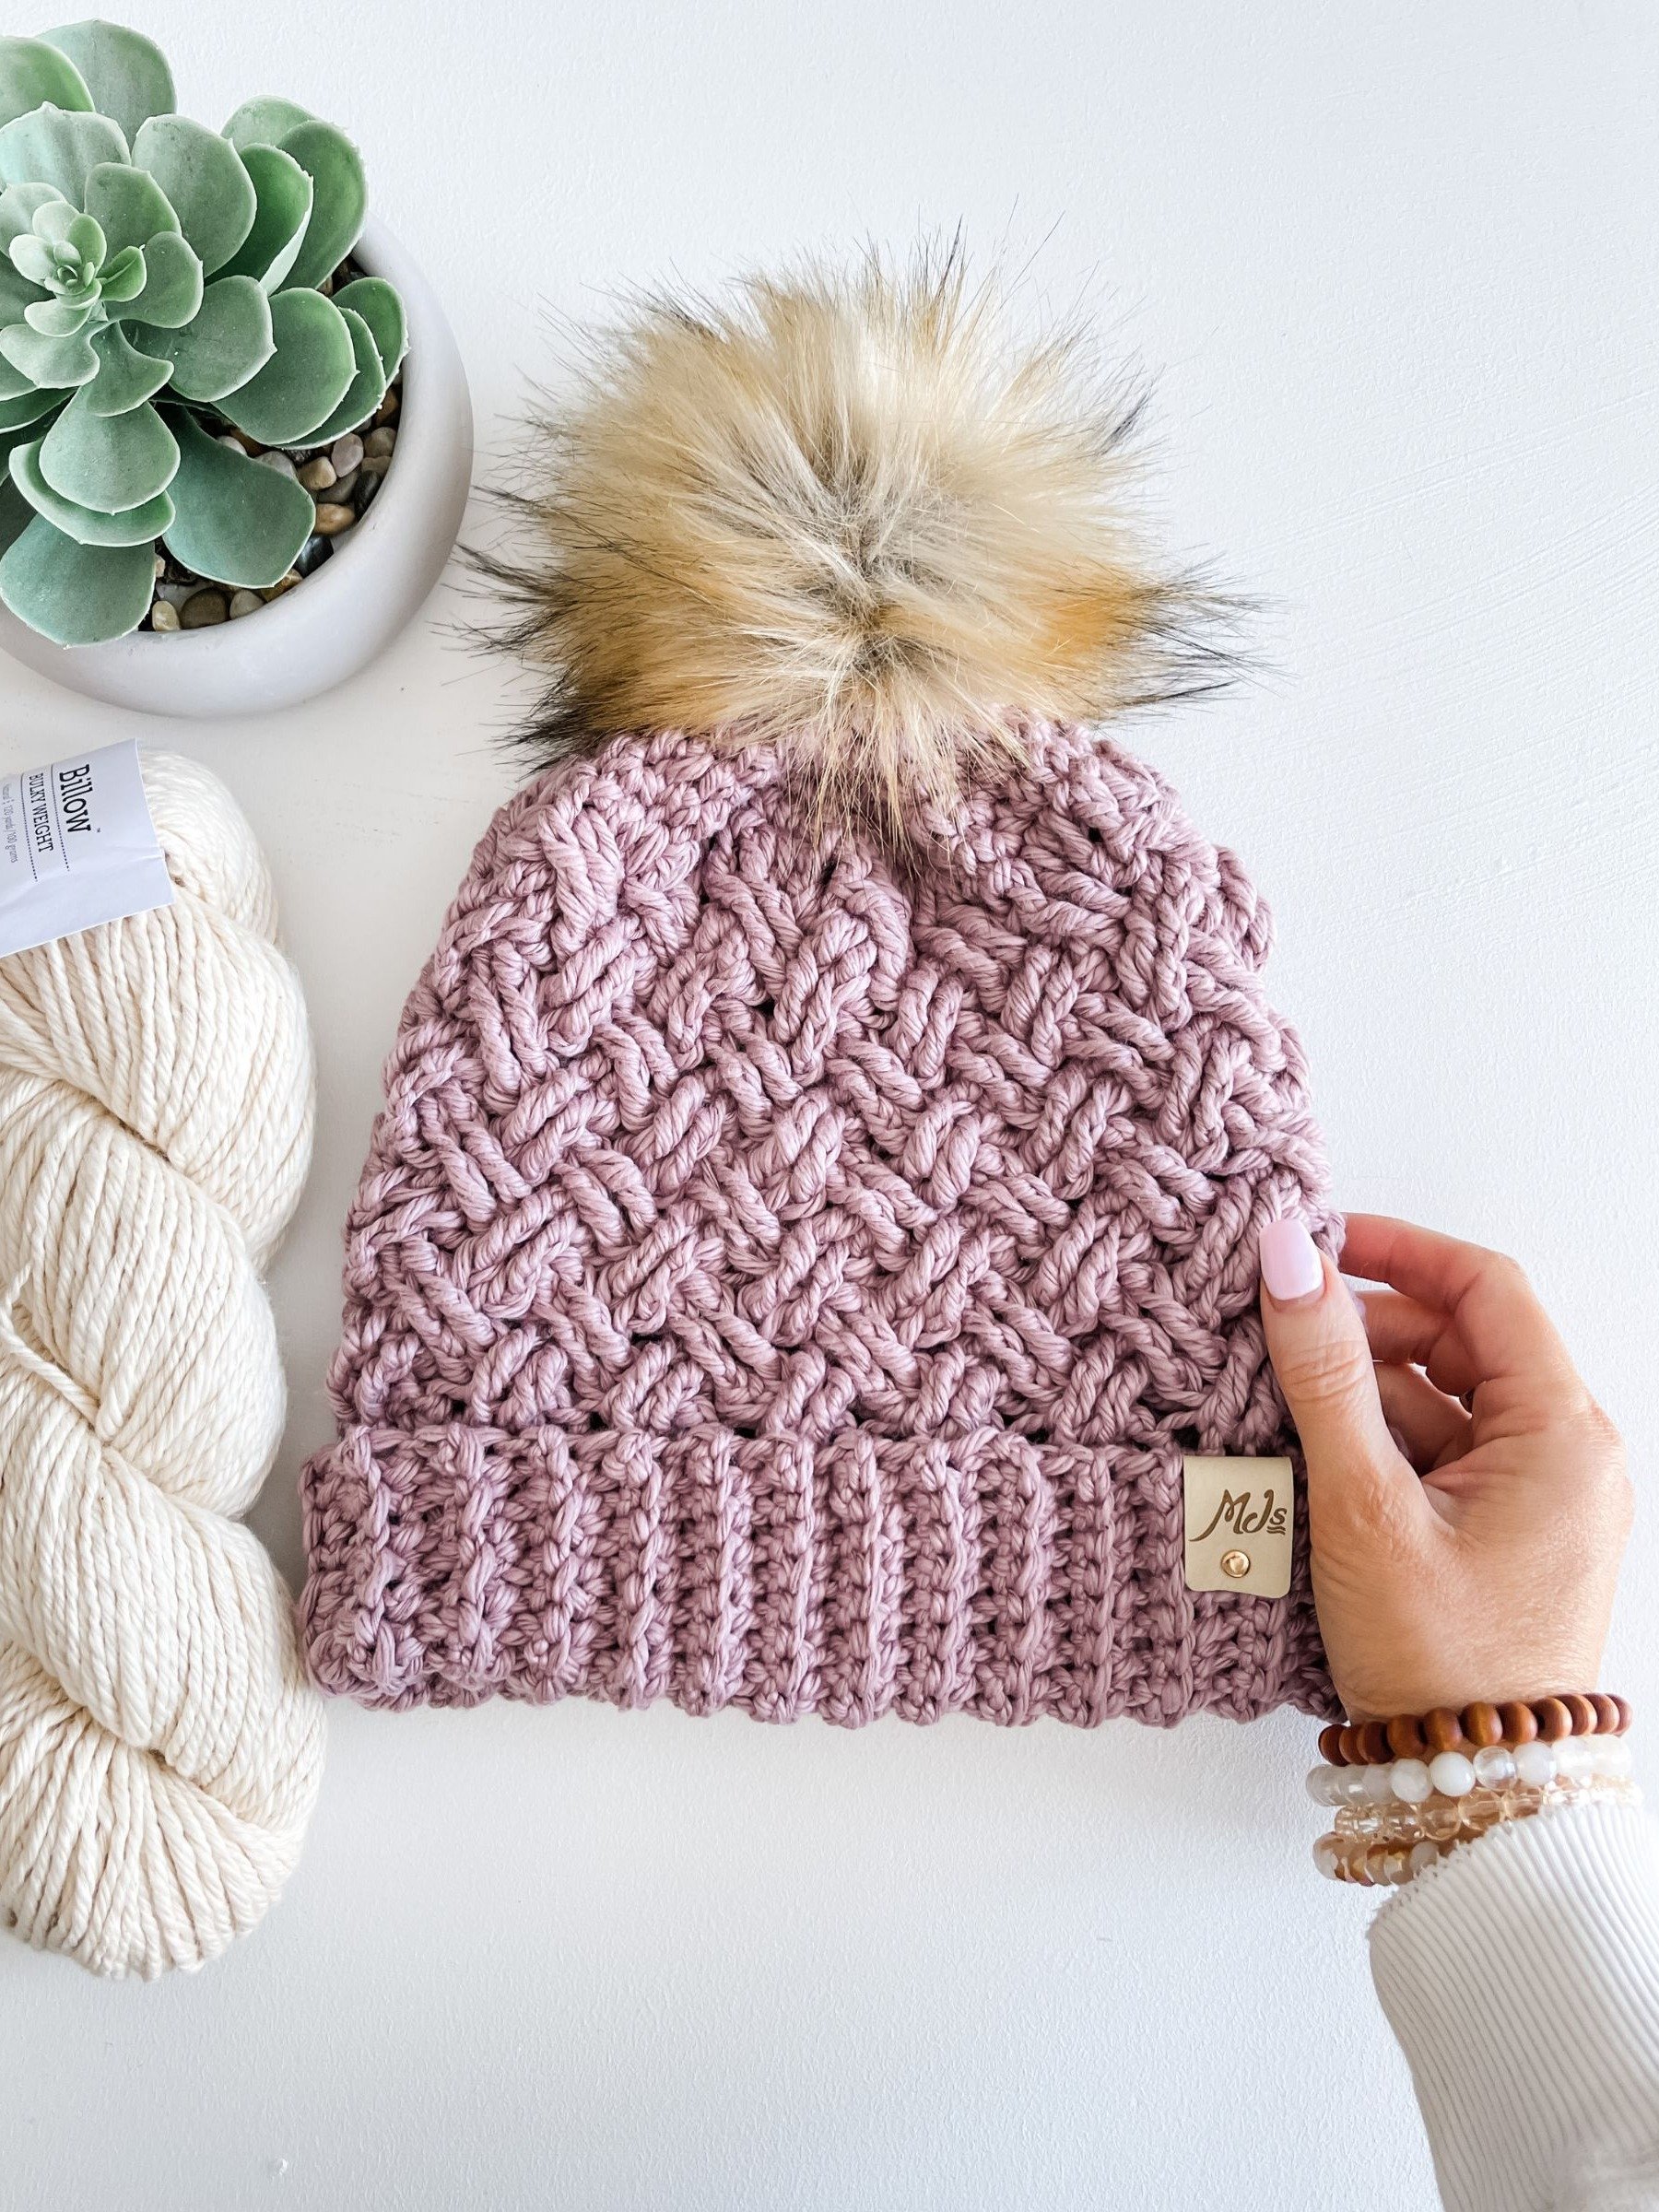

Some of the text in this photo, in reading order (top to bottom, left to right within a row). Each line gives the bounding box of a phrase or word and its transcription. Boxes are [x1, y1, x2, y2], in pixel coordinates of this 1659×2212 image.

[29, 772, 54, 853] BULKY WEIGHT
[59, 763, 93, 832] Billow
